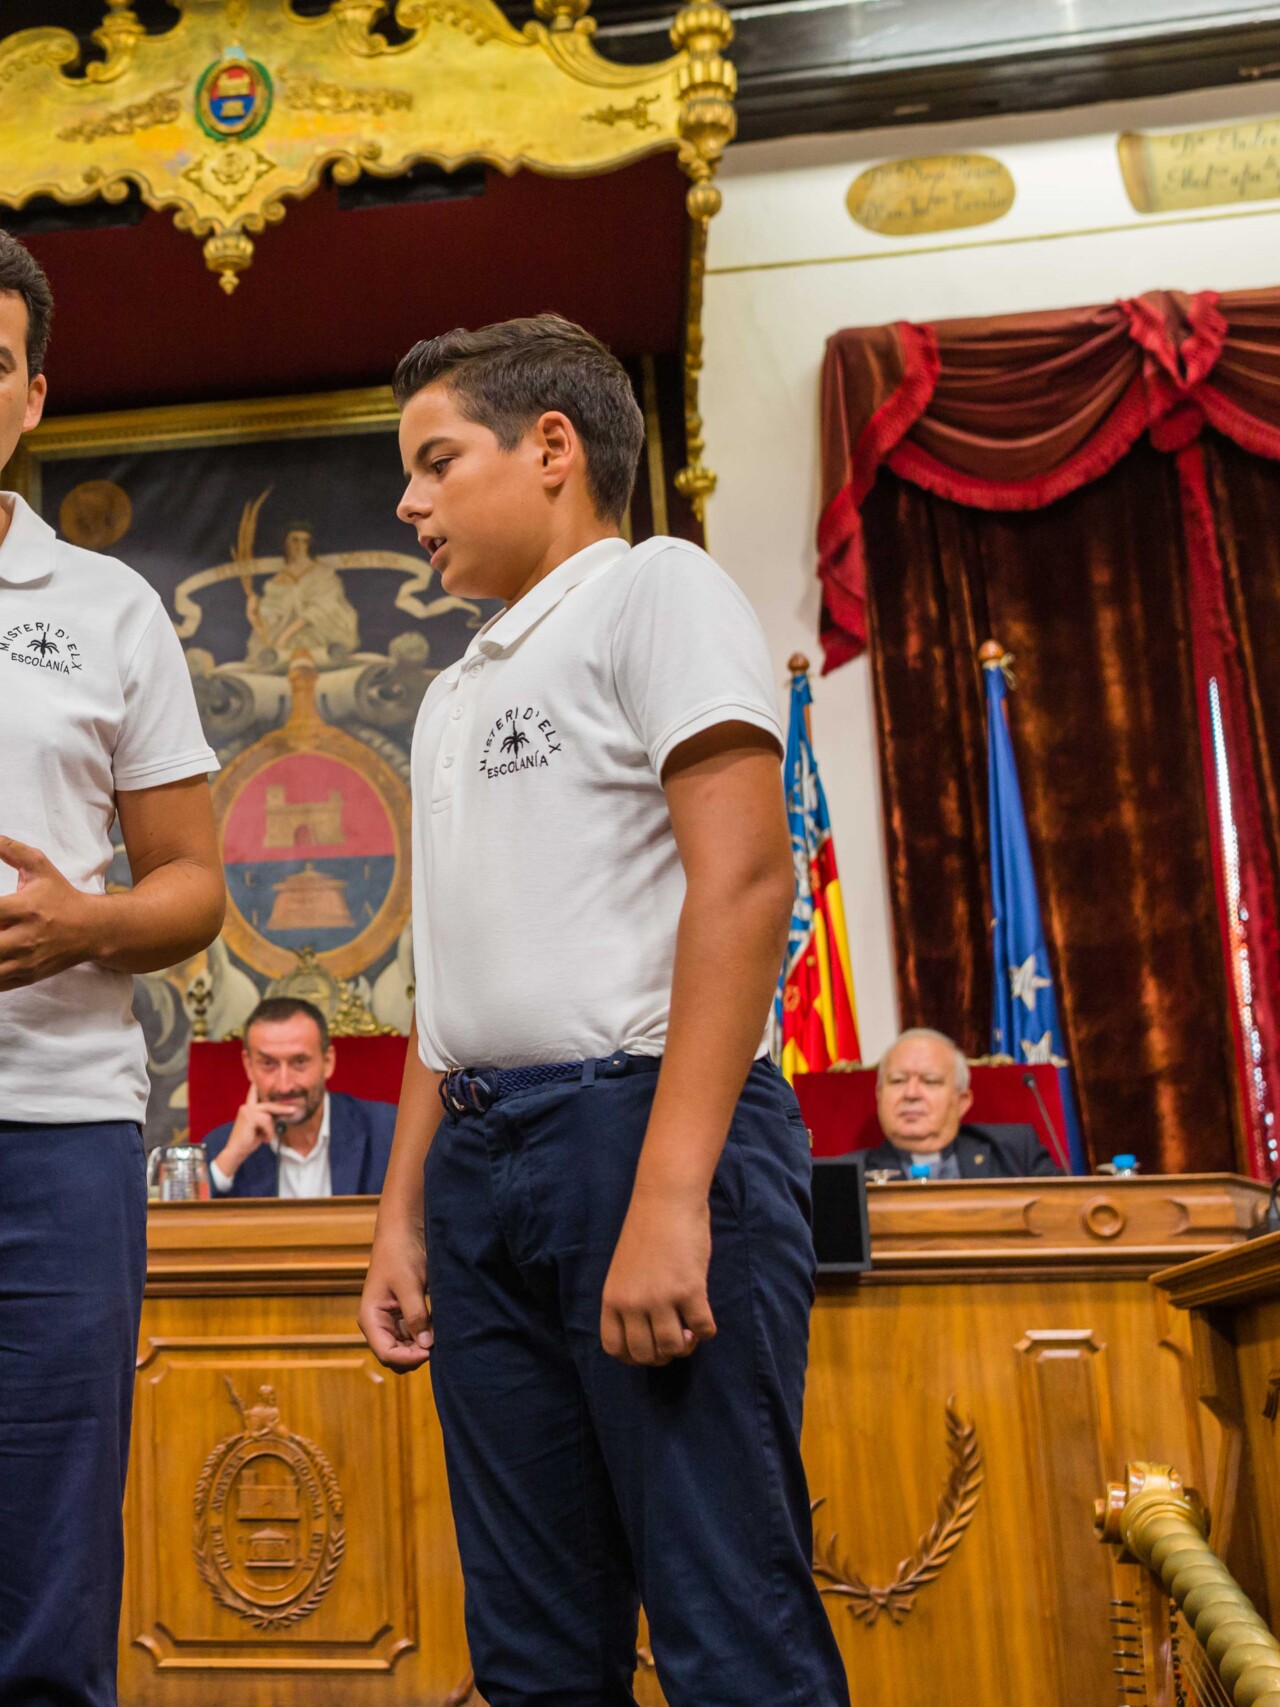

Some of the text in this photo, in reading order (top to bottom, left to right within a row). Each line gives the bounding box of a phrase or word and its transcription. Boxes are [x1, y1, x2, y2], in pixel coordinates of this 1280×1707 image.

[11, 652, 70, 675] ESCOLANÍA
[479, 707, 519, 772] MISTERI
[487, 750, 549, 779] ESCOLANÍA
